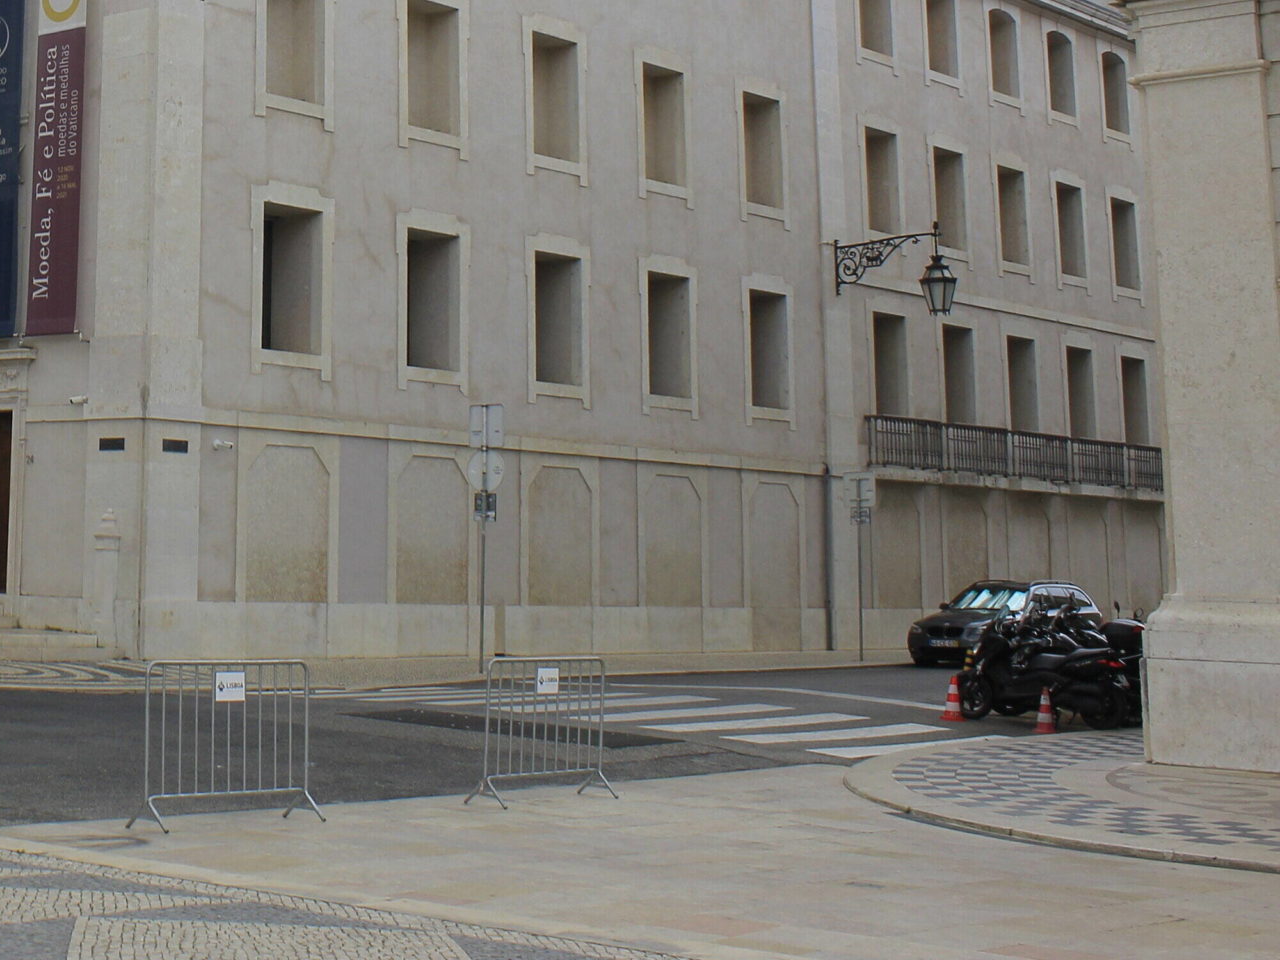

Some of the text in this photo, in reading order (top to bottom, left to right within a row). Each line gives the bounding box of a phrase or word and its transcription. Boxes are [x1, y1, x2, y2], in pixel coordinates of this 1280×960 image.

[57, 43, 70, 157] moedas e medalhas
[67, 89, 79, 156] do Vaticano
[32, 44, 58, 300] Moeda, Fé e Política
